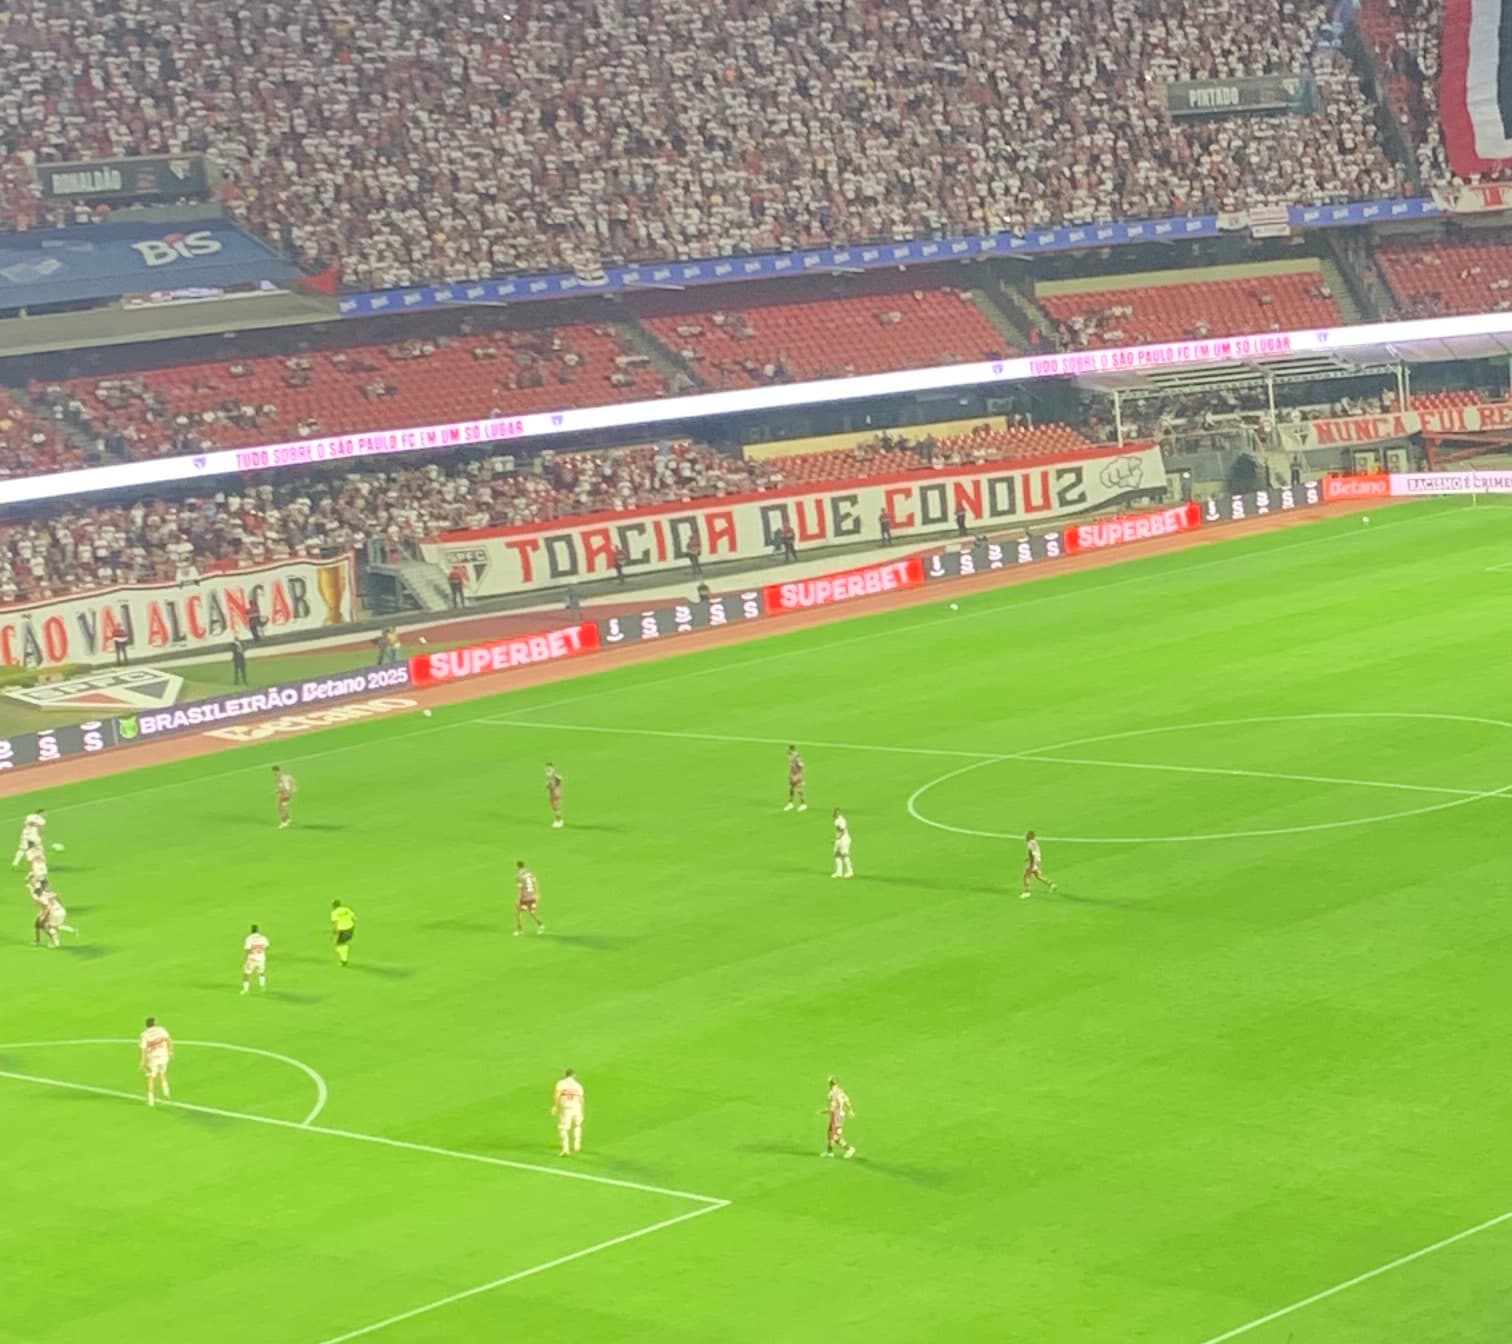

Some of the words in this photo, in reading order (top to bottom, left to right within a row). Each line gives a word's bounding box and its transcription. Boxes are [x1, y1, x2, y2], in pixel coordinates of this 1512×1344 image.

[1313, 413, 1408, 445] NUNCA
[1418, 406, 1466, 434] FUI
[505, 510, 738, 583] TORCIDA
[1076, 506, 1191, 550] SUPERBET
[780, 561, 909, 610] SUPERBET
[430, 624, 584, 679] SUPERBET
[140, 687, 298, 735] BRASILEIRÃO
[301, 675, 367, 703] Betano
[367, 666, 409, 690] 2025
